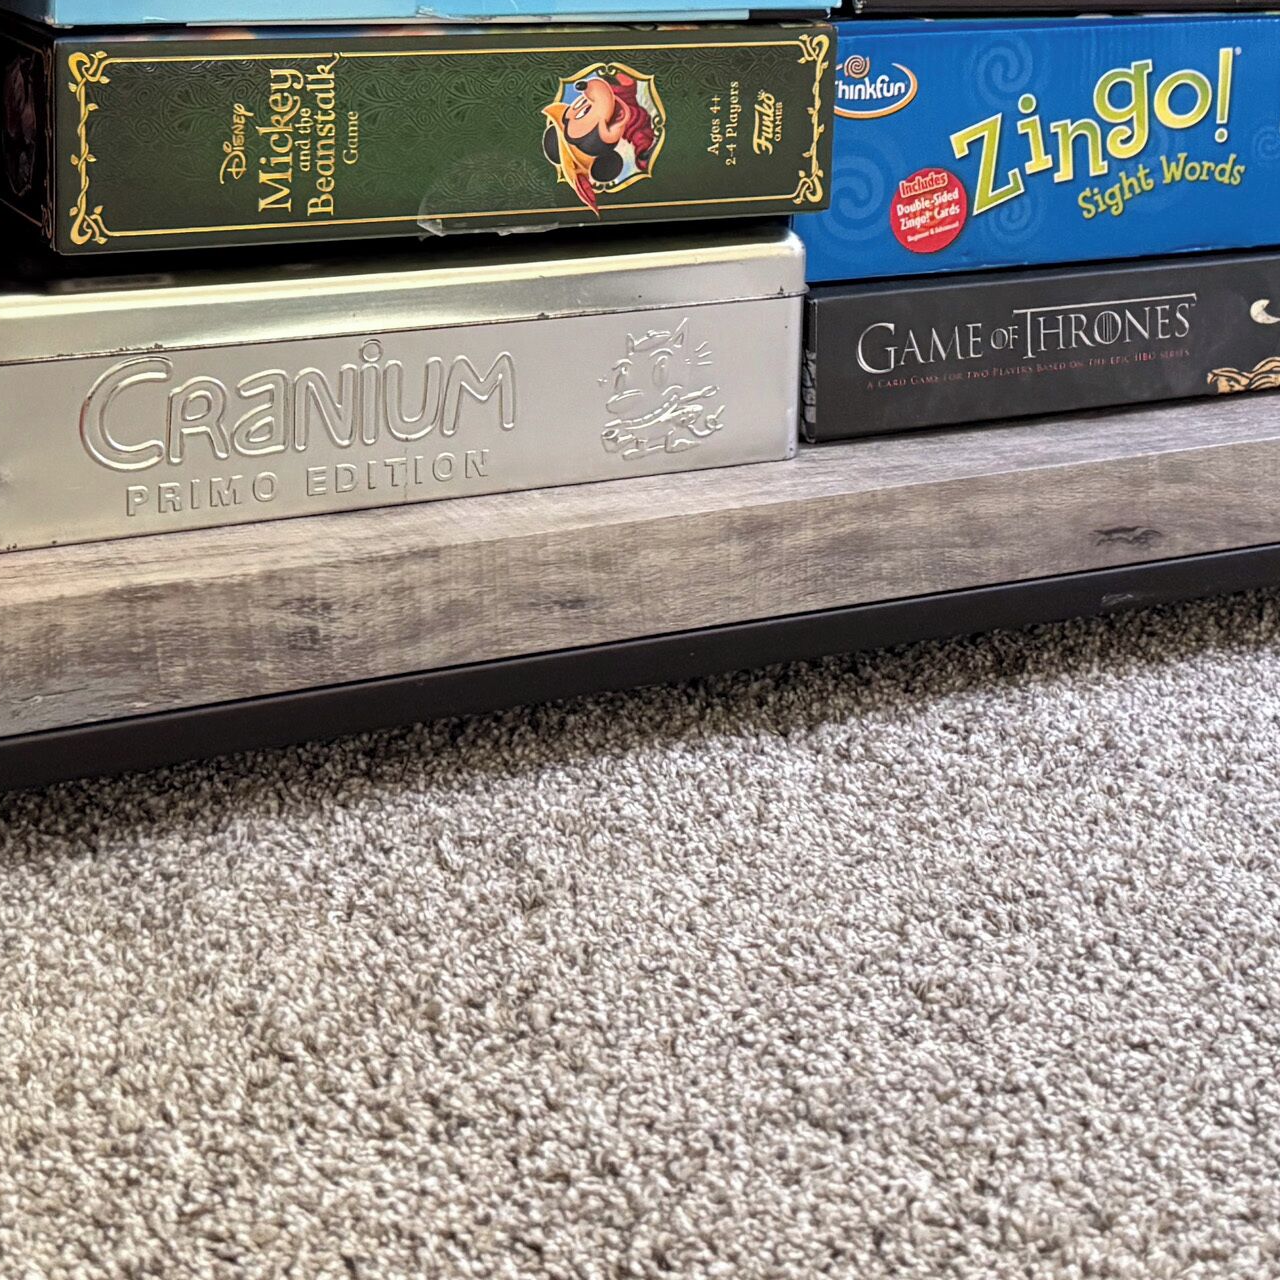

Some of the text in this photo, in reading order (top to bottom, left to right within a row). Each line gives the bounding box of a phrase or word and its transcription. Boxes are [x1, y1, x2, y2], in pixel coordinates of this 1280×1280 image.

[835, 74, 907, 101] hinkfun
[256, 67, 302, 213] Mickey
[296, 107, 314, 172] and the
[305, 52, 341, 217] Beanstalk
[343, 110, 360, 165] Game
[707, 113, 723, 155] Ages
[725, 81, 740, 166] 2-4 Players
[752, 90, 775, 155] Funko
[774, 101, 783, 143] GAMES
[949, 47, 1234, 217] Zingo!
[896, 187, 960, 216] Double-Sided
[900, 172, 948, 198] Includes
[933, 203, 960, 220] Cards
[1078, 152, 1246, 221] Sight Words
[856, 293, 1196, 375] GAME OF THRONES
[127, 449, 492, 517] PRIMO EDITION
